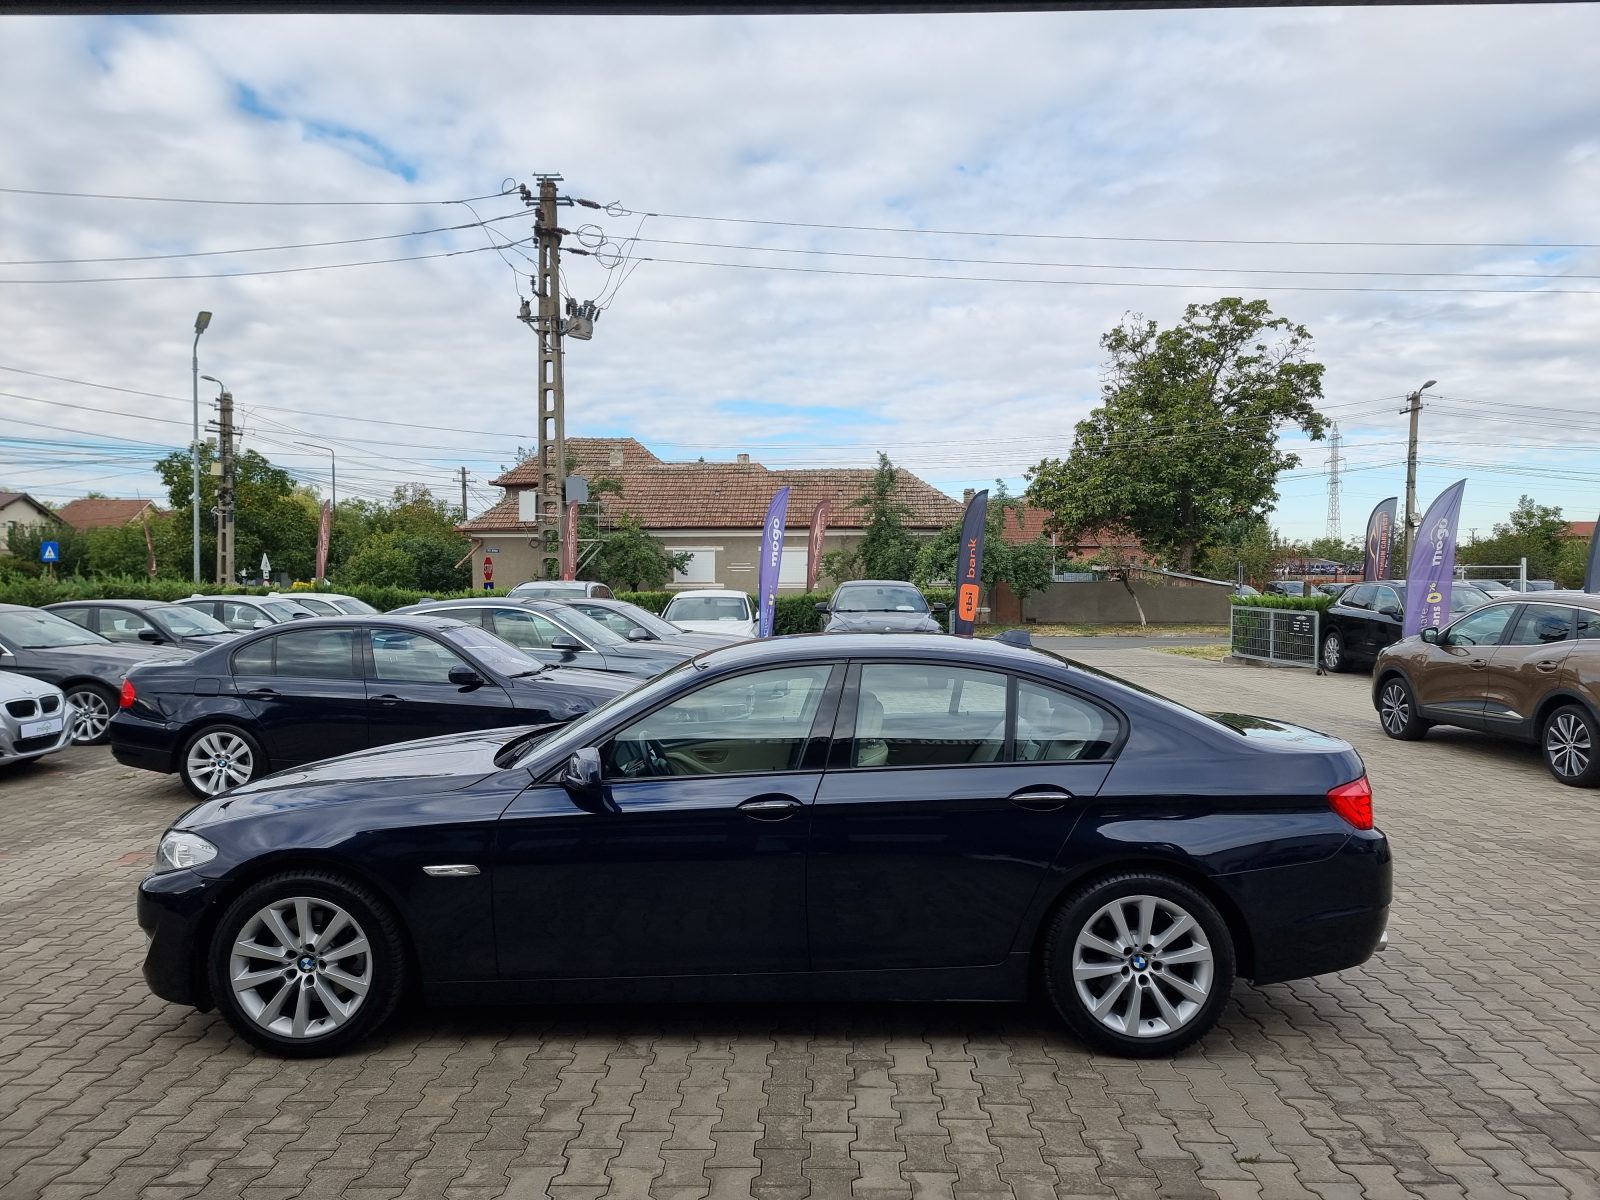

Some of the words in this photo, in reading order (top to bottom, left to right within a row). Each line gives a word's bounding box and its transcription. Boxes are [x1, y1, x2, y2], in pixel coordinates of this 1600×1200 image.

[771, 518, 782, 567] mogo
[967, 538, 977, 578] bank
[1432, 518, 1449, 567] mogo
